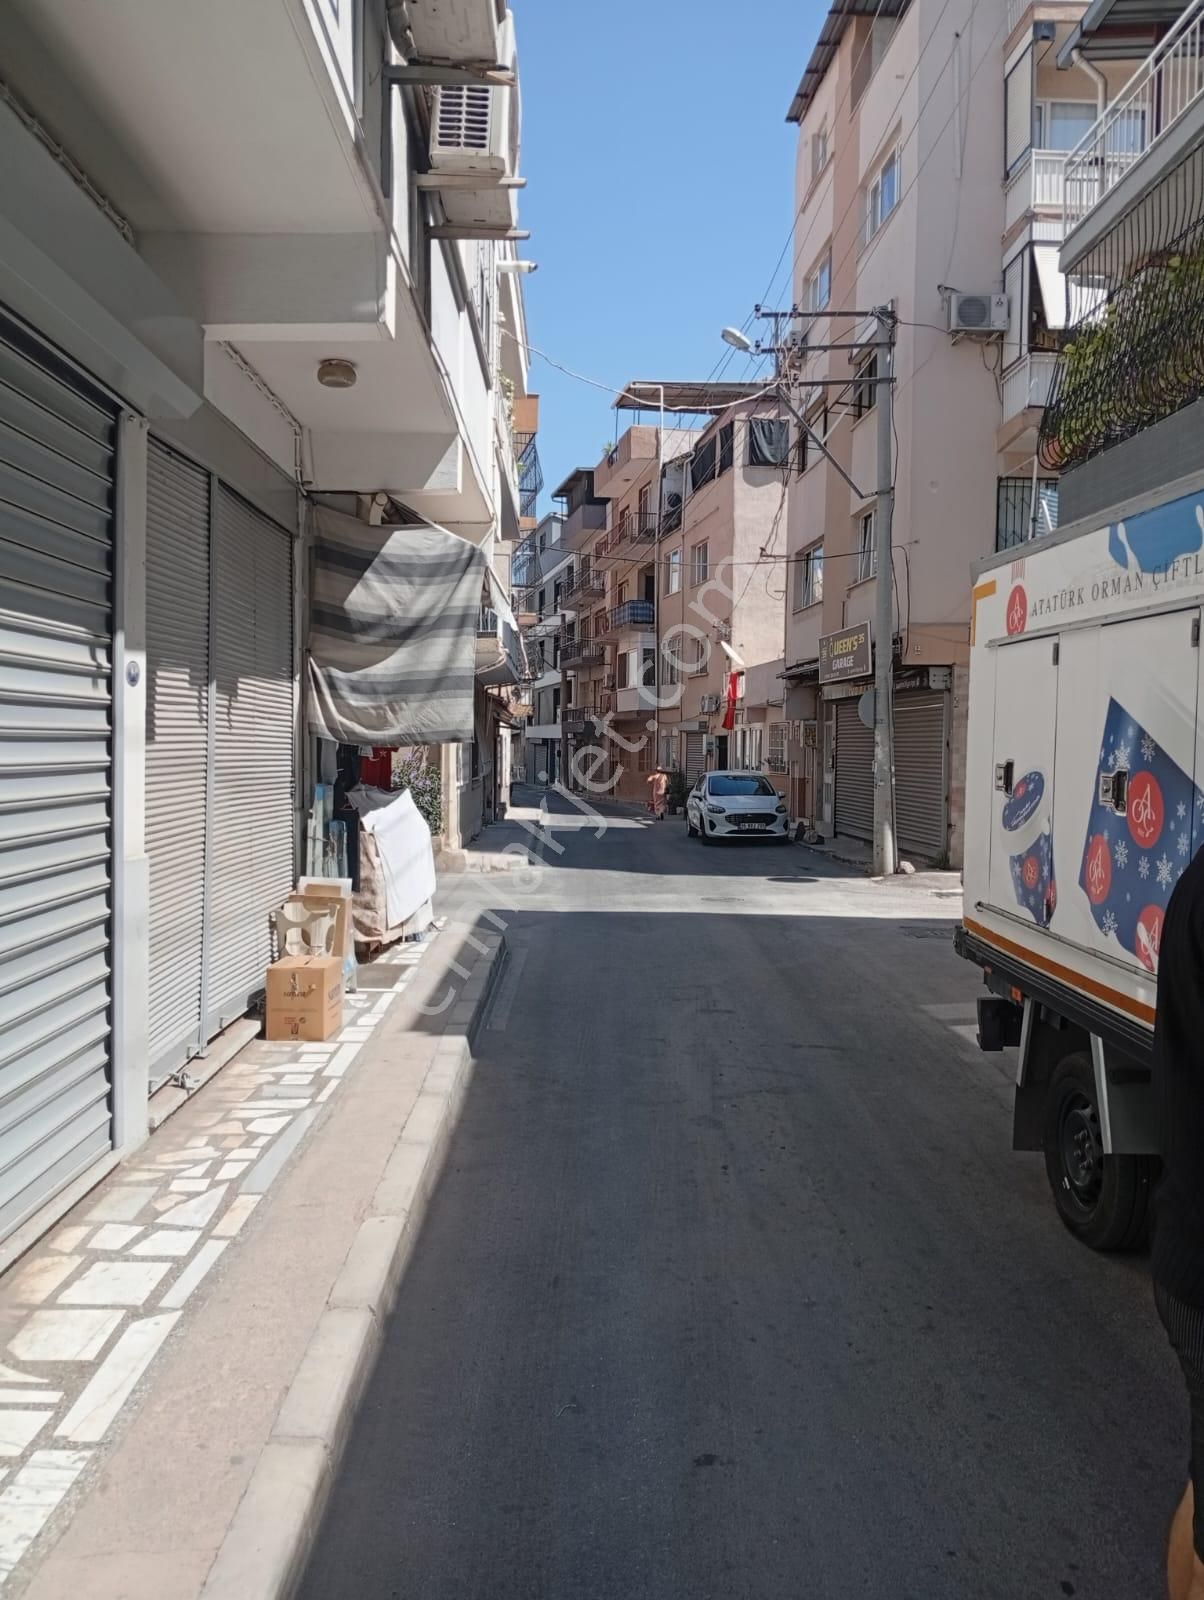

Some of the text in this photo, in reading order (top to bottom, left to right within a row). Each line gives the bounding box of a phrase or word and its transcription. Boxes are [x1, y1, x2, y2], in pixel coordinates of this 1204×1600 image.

[1031, 589, 1085, 617] ATATÜRK
[1091, 571, 1143, 599] ORMAN
[832, 656, 854, 670] GARAGE
